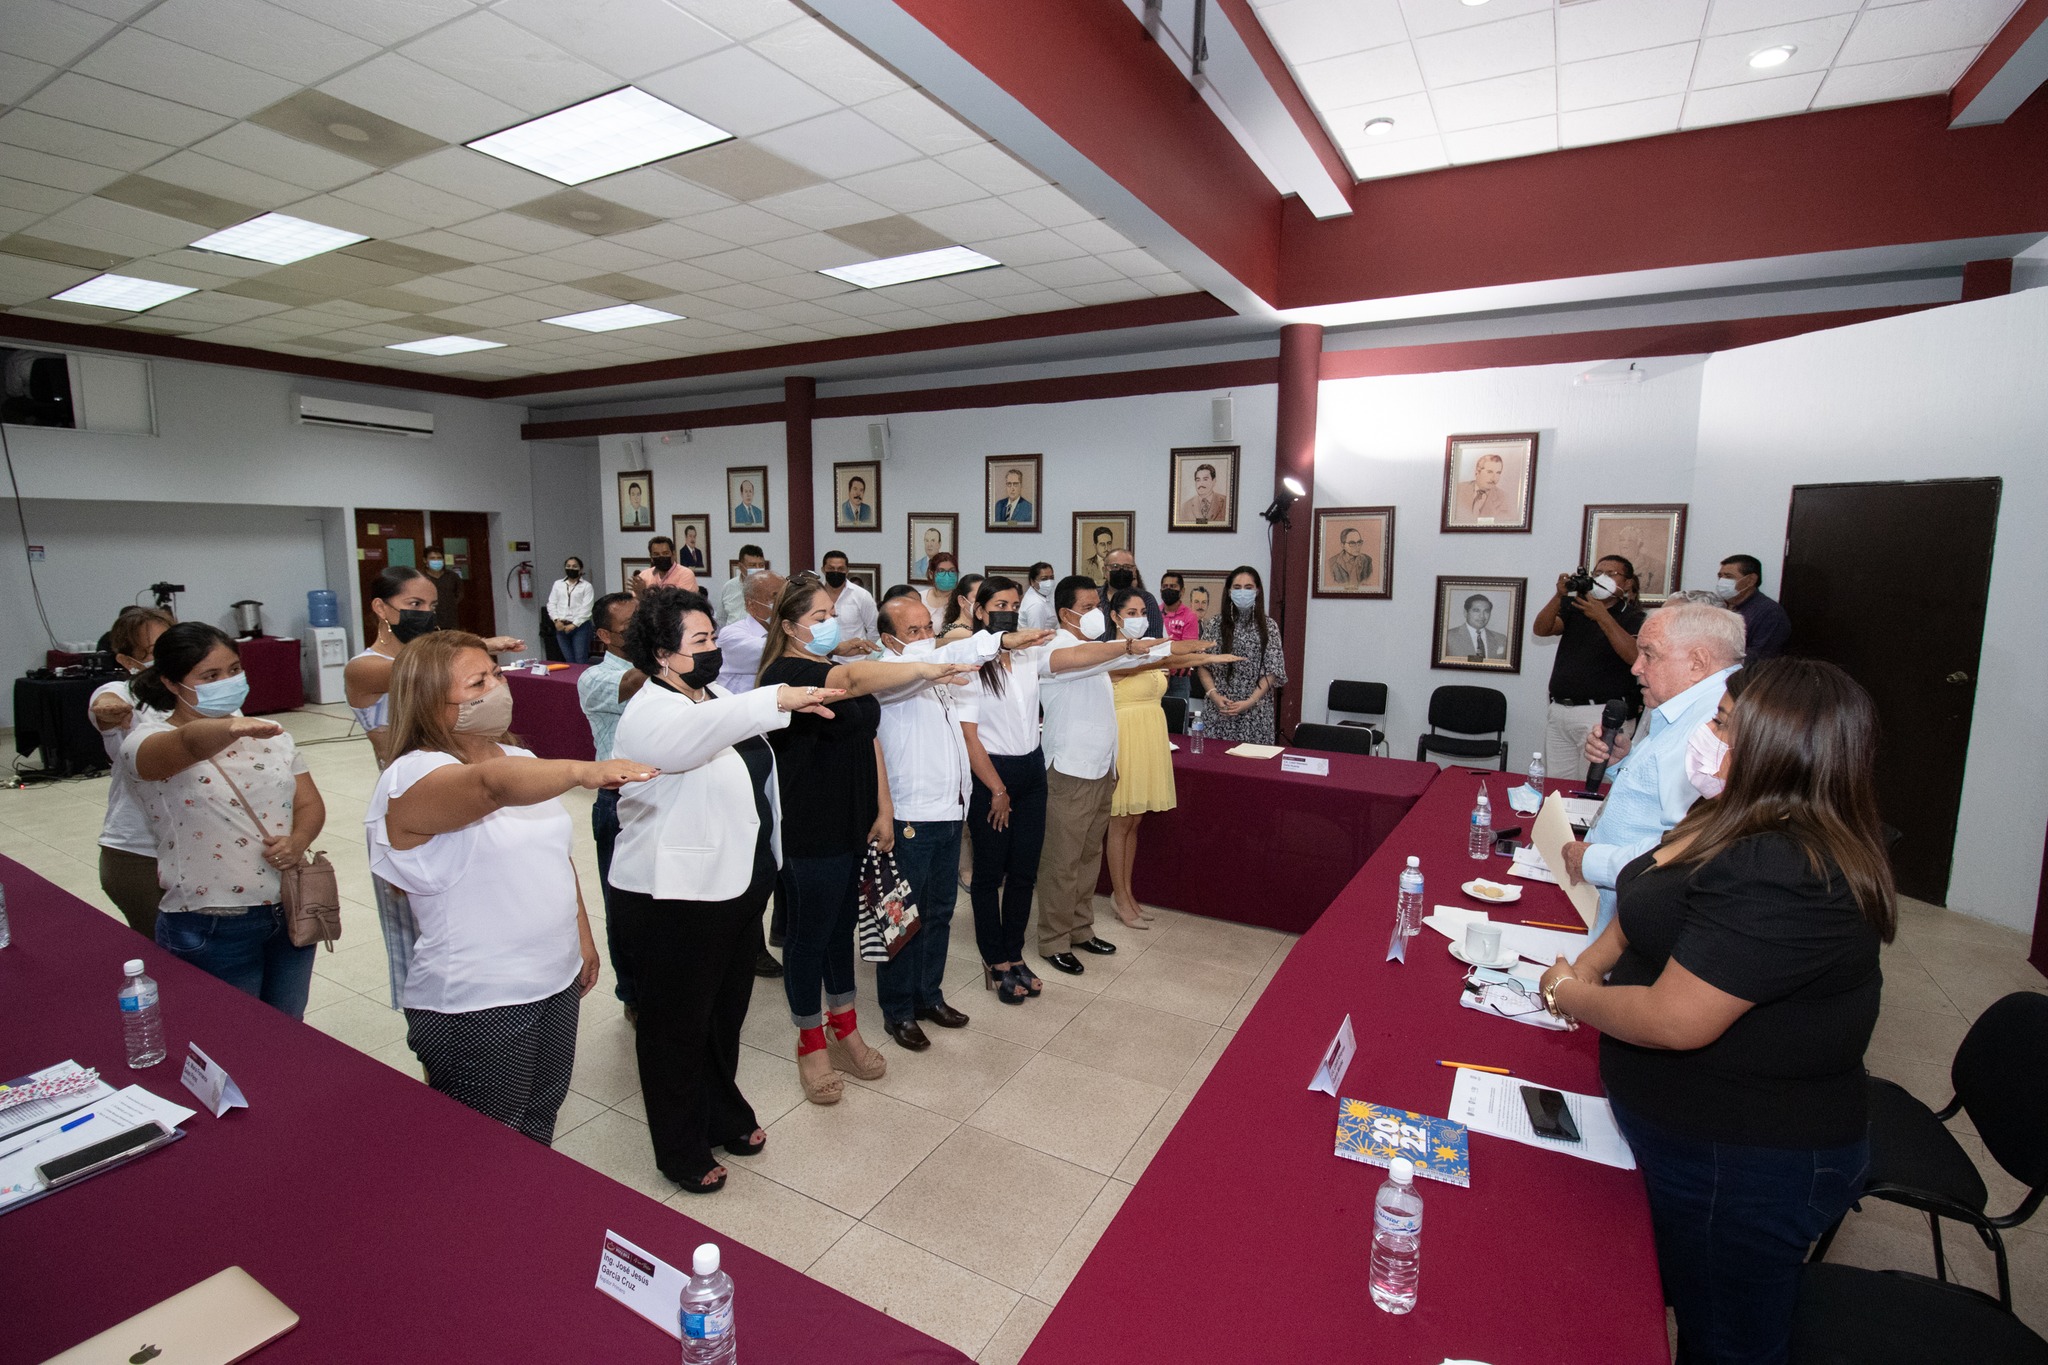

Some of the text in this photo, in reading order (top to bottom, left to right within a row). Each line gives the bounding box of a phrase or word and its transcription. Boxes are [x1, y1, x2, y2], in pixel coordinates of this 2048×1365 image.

[1373, 1117, 1400, 1147] 20
[1399, 1124, 1427, 1153] 22
[601, 1264, 621, 1282] García
[621, 1276, 637, 1292] Cruz
[603, 1252, 615, 1266] Ing.
[615, 1259, 631, 1275] José
[630, 1269, 650, 1287] Jesús
